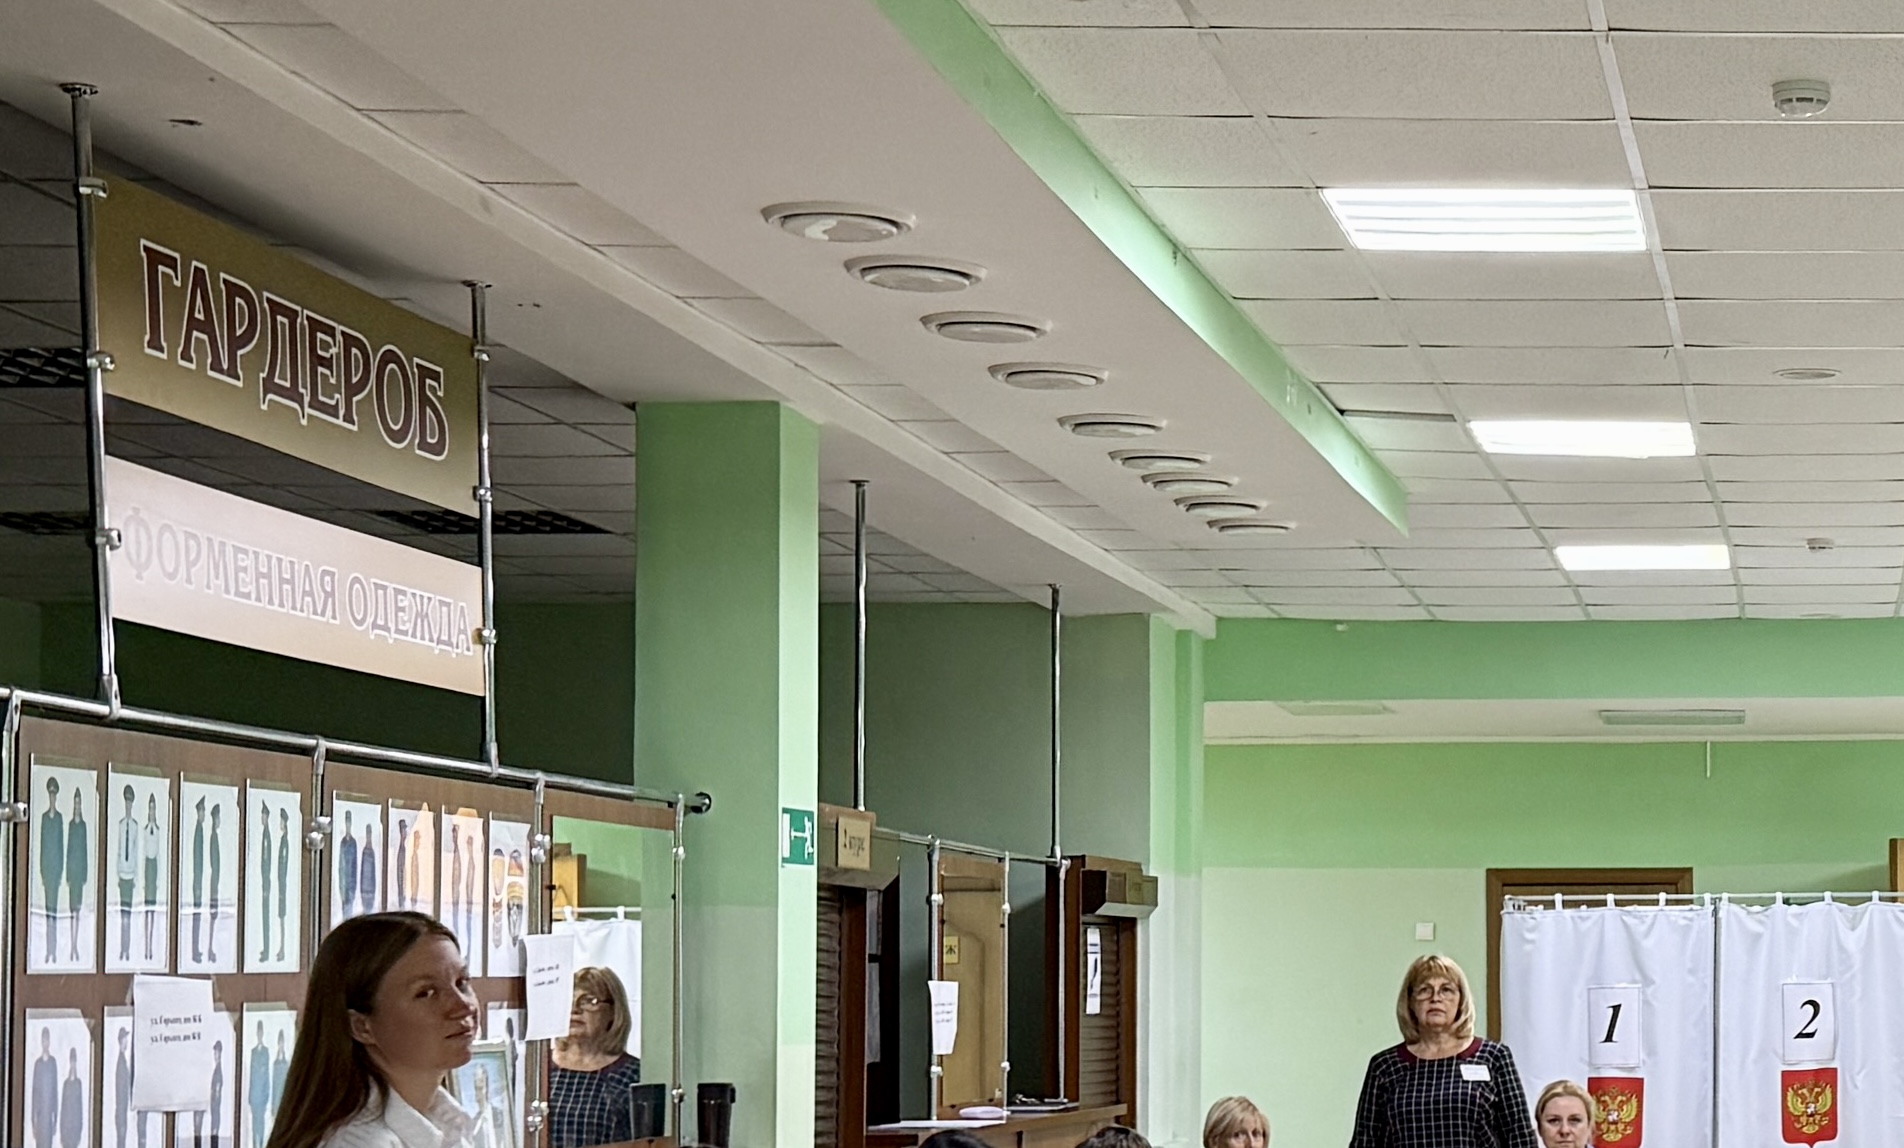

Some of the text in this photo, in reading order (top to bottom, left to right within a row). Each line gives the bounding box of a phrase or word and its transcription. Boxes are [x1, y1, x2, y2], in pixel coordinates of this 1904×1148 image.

[140, 239, 450, 460] ГАРДЕРОБ
[122, 506, 473, 657] ФОРМЕННАЯ ОДЕЖДА
[1598, 1003, 1622, 1044] 1
[1793, 999, 1821, 1039] 2
